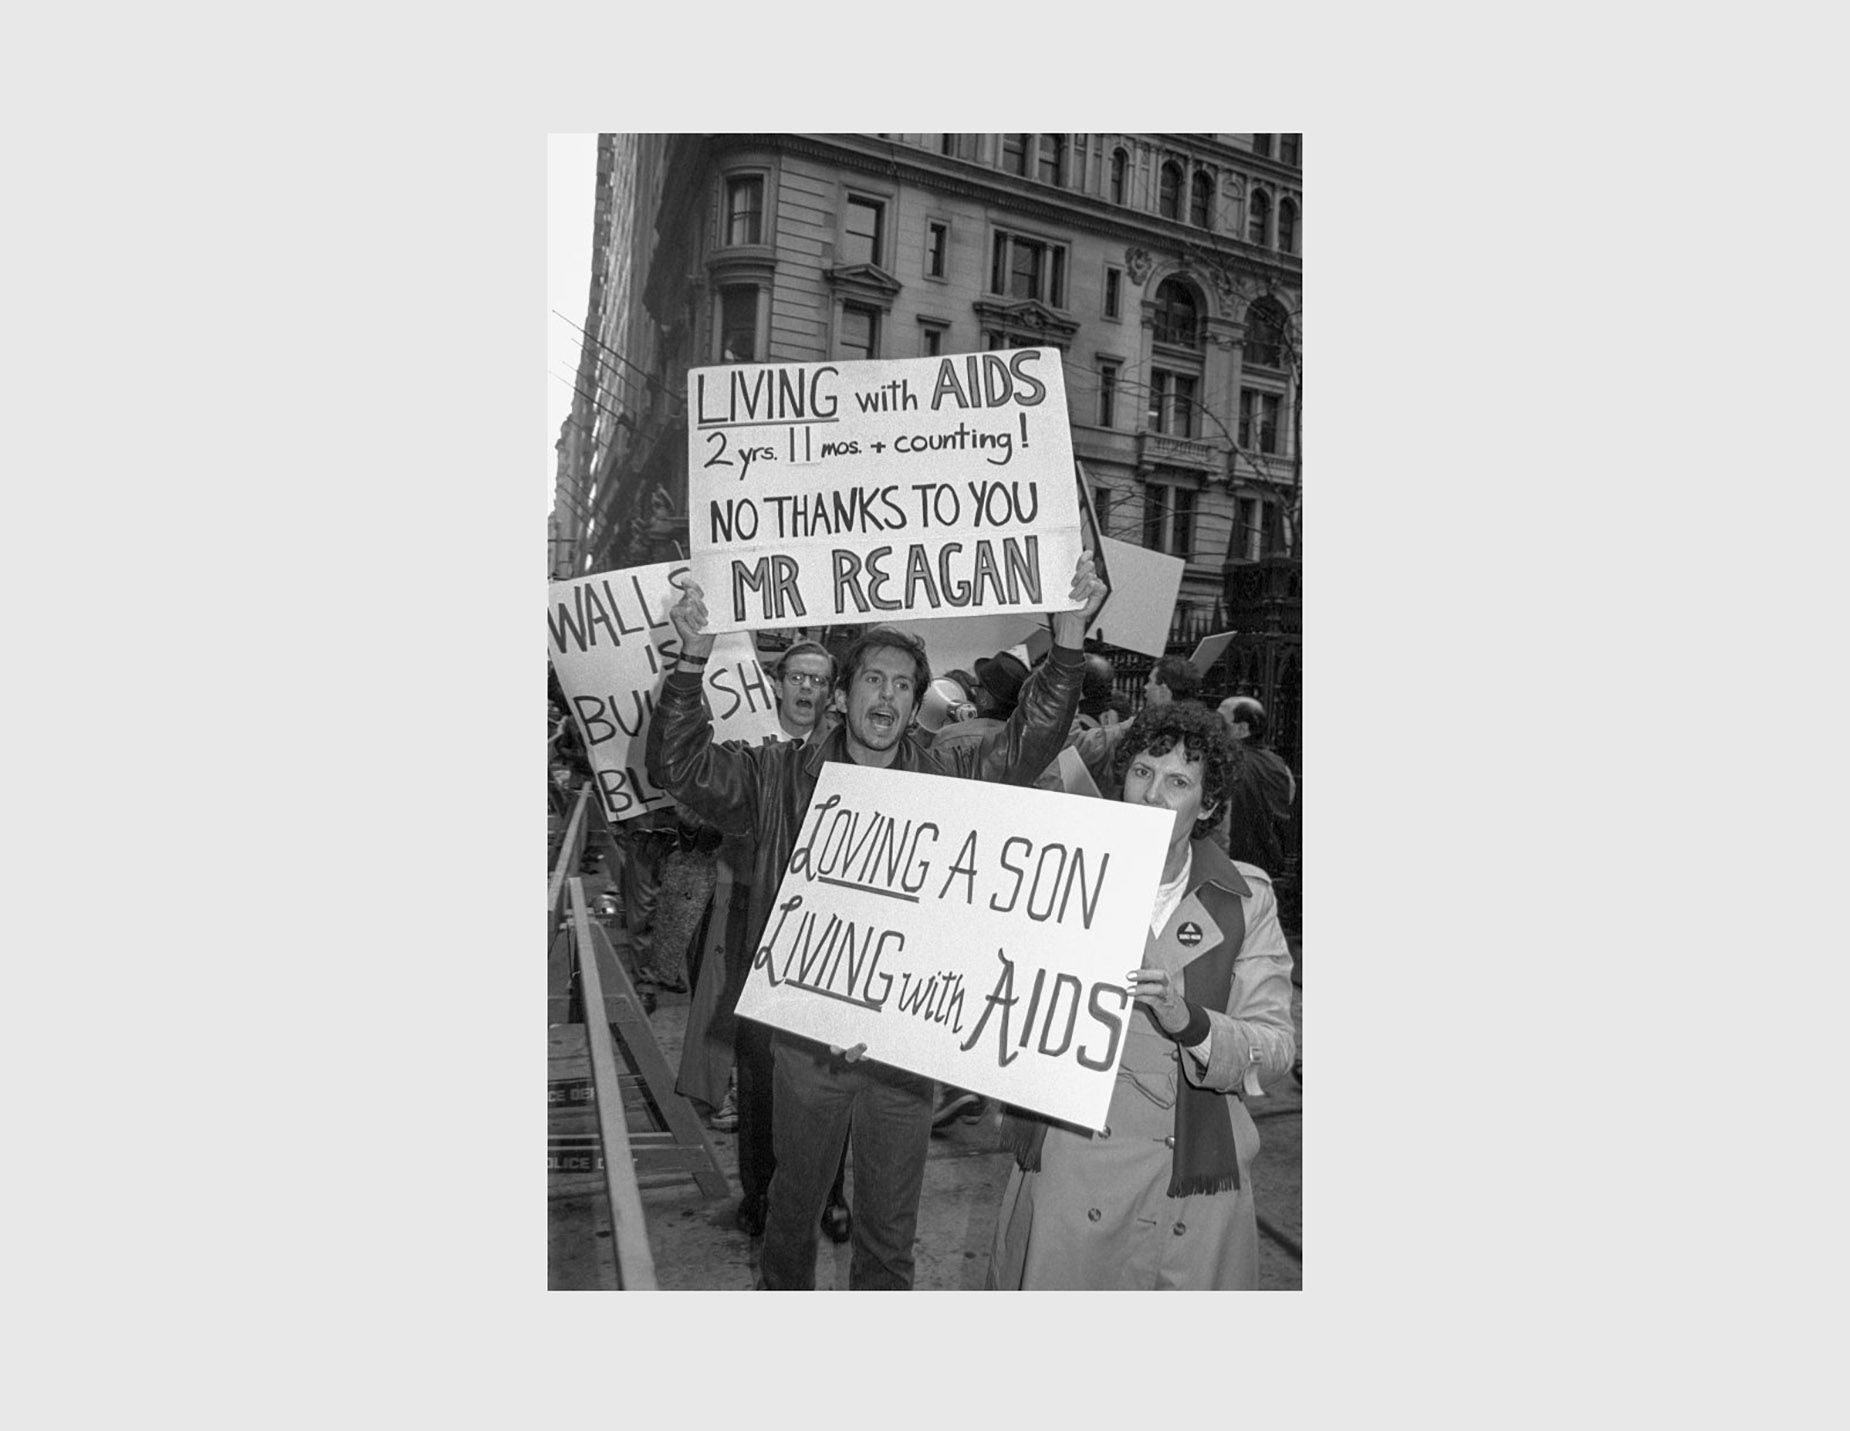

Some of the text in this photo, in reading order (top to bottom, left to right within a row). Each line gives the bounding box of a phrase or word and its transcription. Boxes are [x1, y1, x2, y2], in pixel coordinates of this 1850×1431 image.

[698, 350, 1047, 424] LIVING with AIDS
[704, 432, 734, 468] 2
[738, 444, 778, 481] yrs.
[821, 440, 862, 459] mos.
[710, 481, 1039, 544] NO THANKS TO YOU
[731, 535, 1043, 622] MR REAGAN
[790, 794, 1110, 930] LOVING A SON
[754, 895, 1128, 1073] LIVING with AIDS
